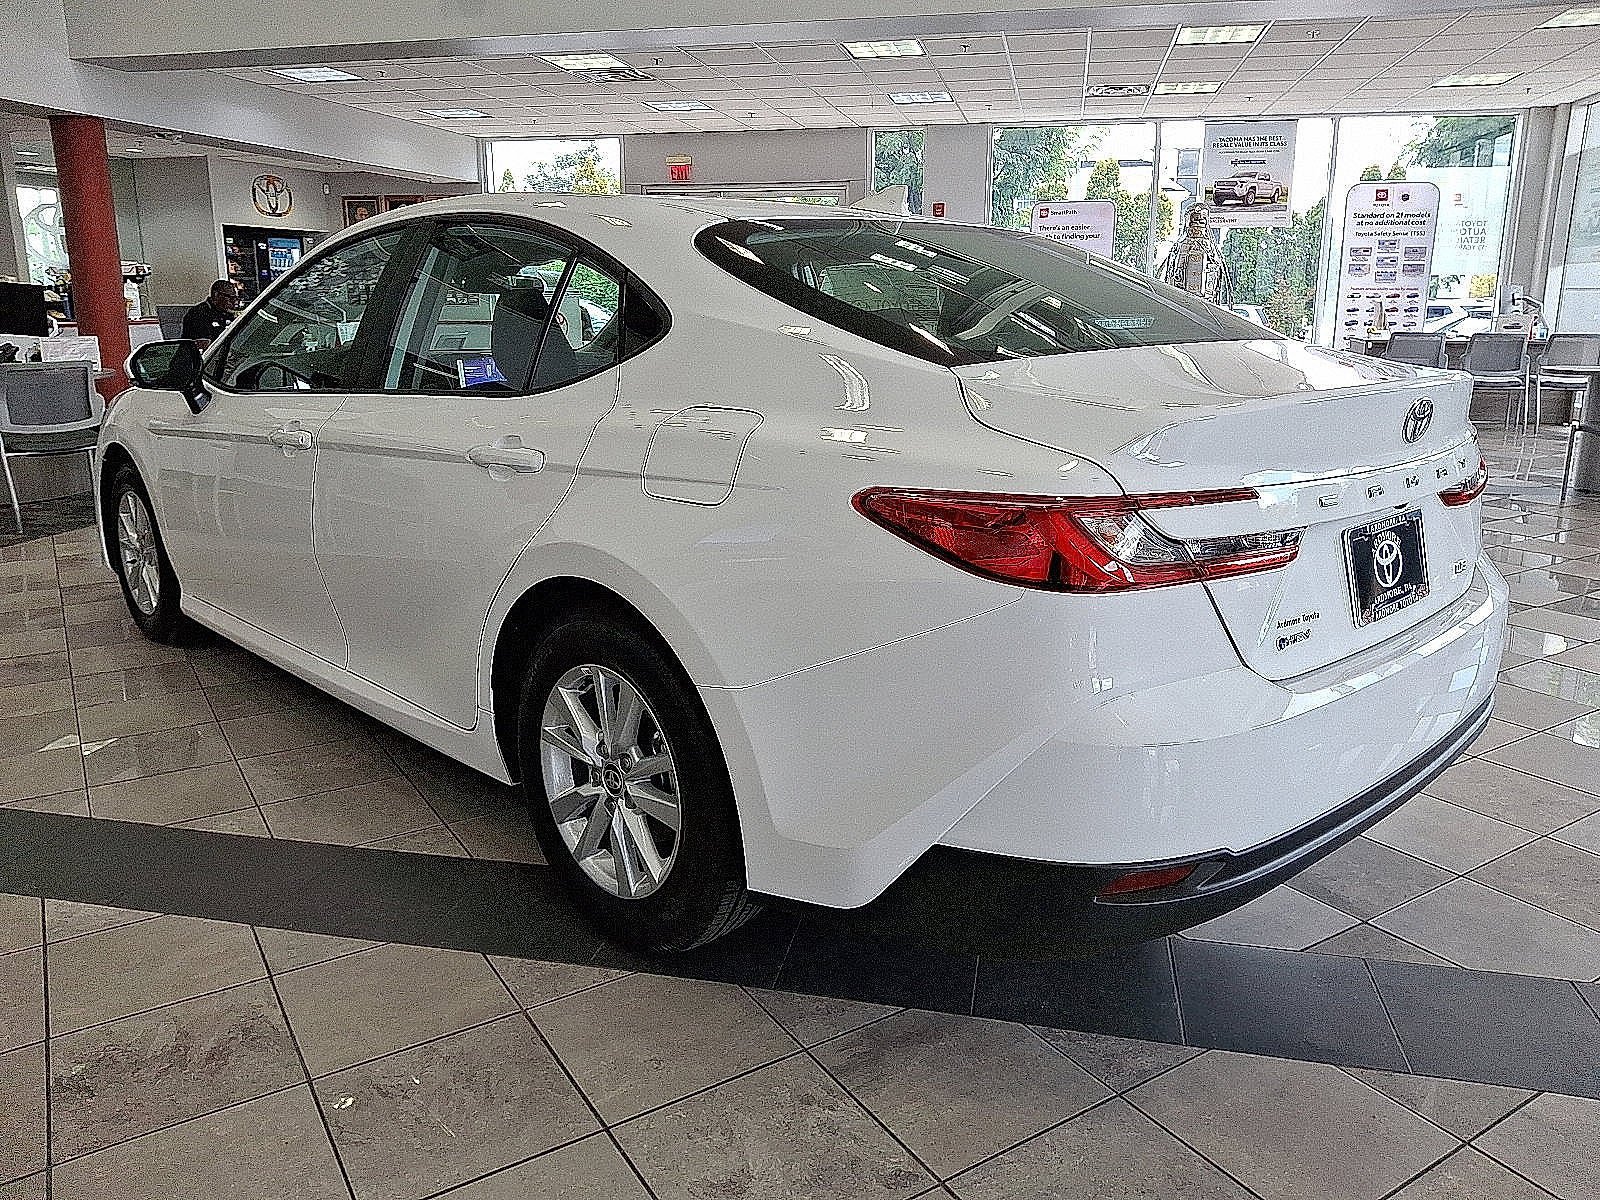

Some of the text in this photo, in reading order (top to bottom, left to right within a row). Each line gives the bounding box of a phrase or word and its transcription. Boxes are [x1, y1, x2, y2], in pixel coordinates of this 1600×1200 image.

[670, 165, 690, 180] EXIT
[1352, 211, 1386, 219] Standard
[1395, 211, 1404, 219] 21
[1403, 211, 1431, 219] models
[1038, 224, 1061, 232] There's
[1061, 233, 1085, 241] finding
[1085, 233, 1101, 241] your
[1276, 610, 1320, 630] Ardmore Toyota
